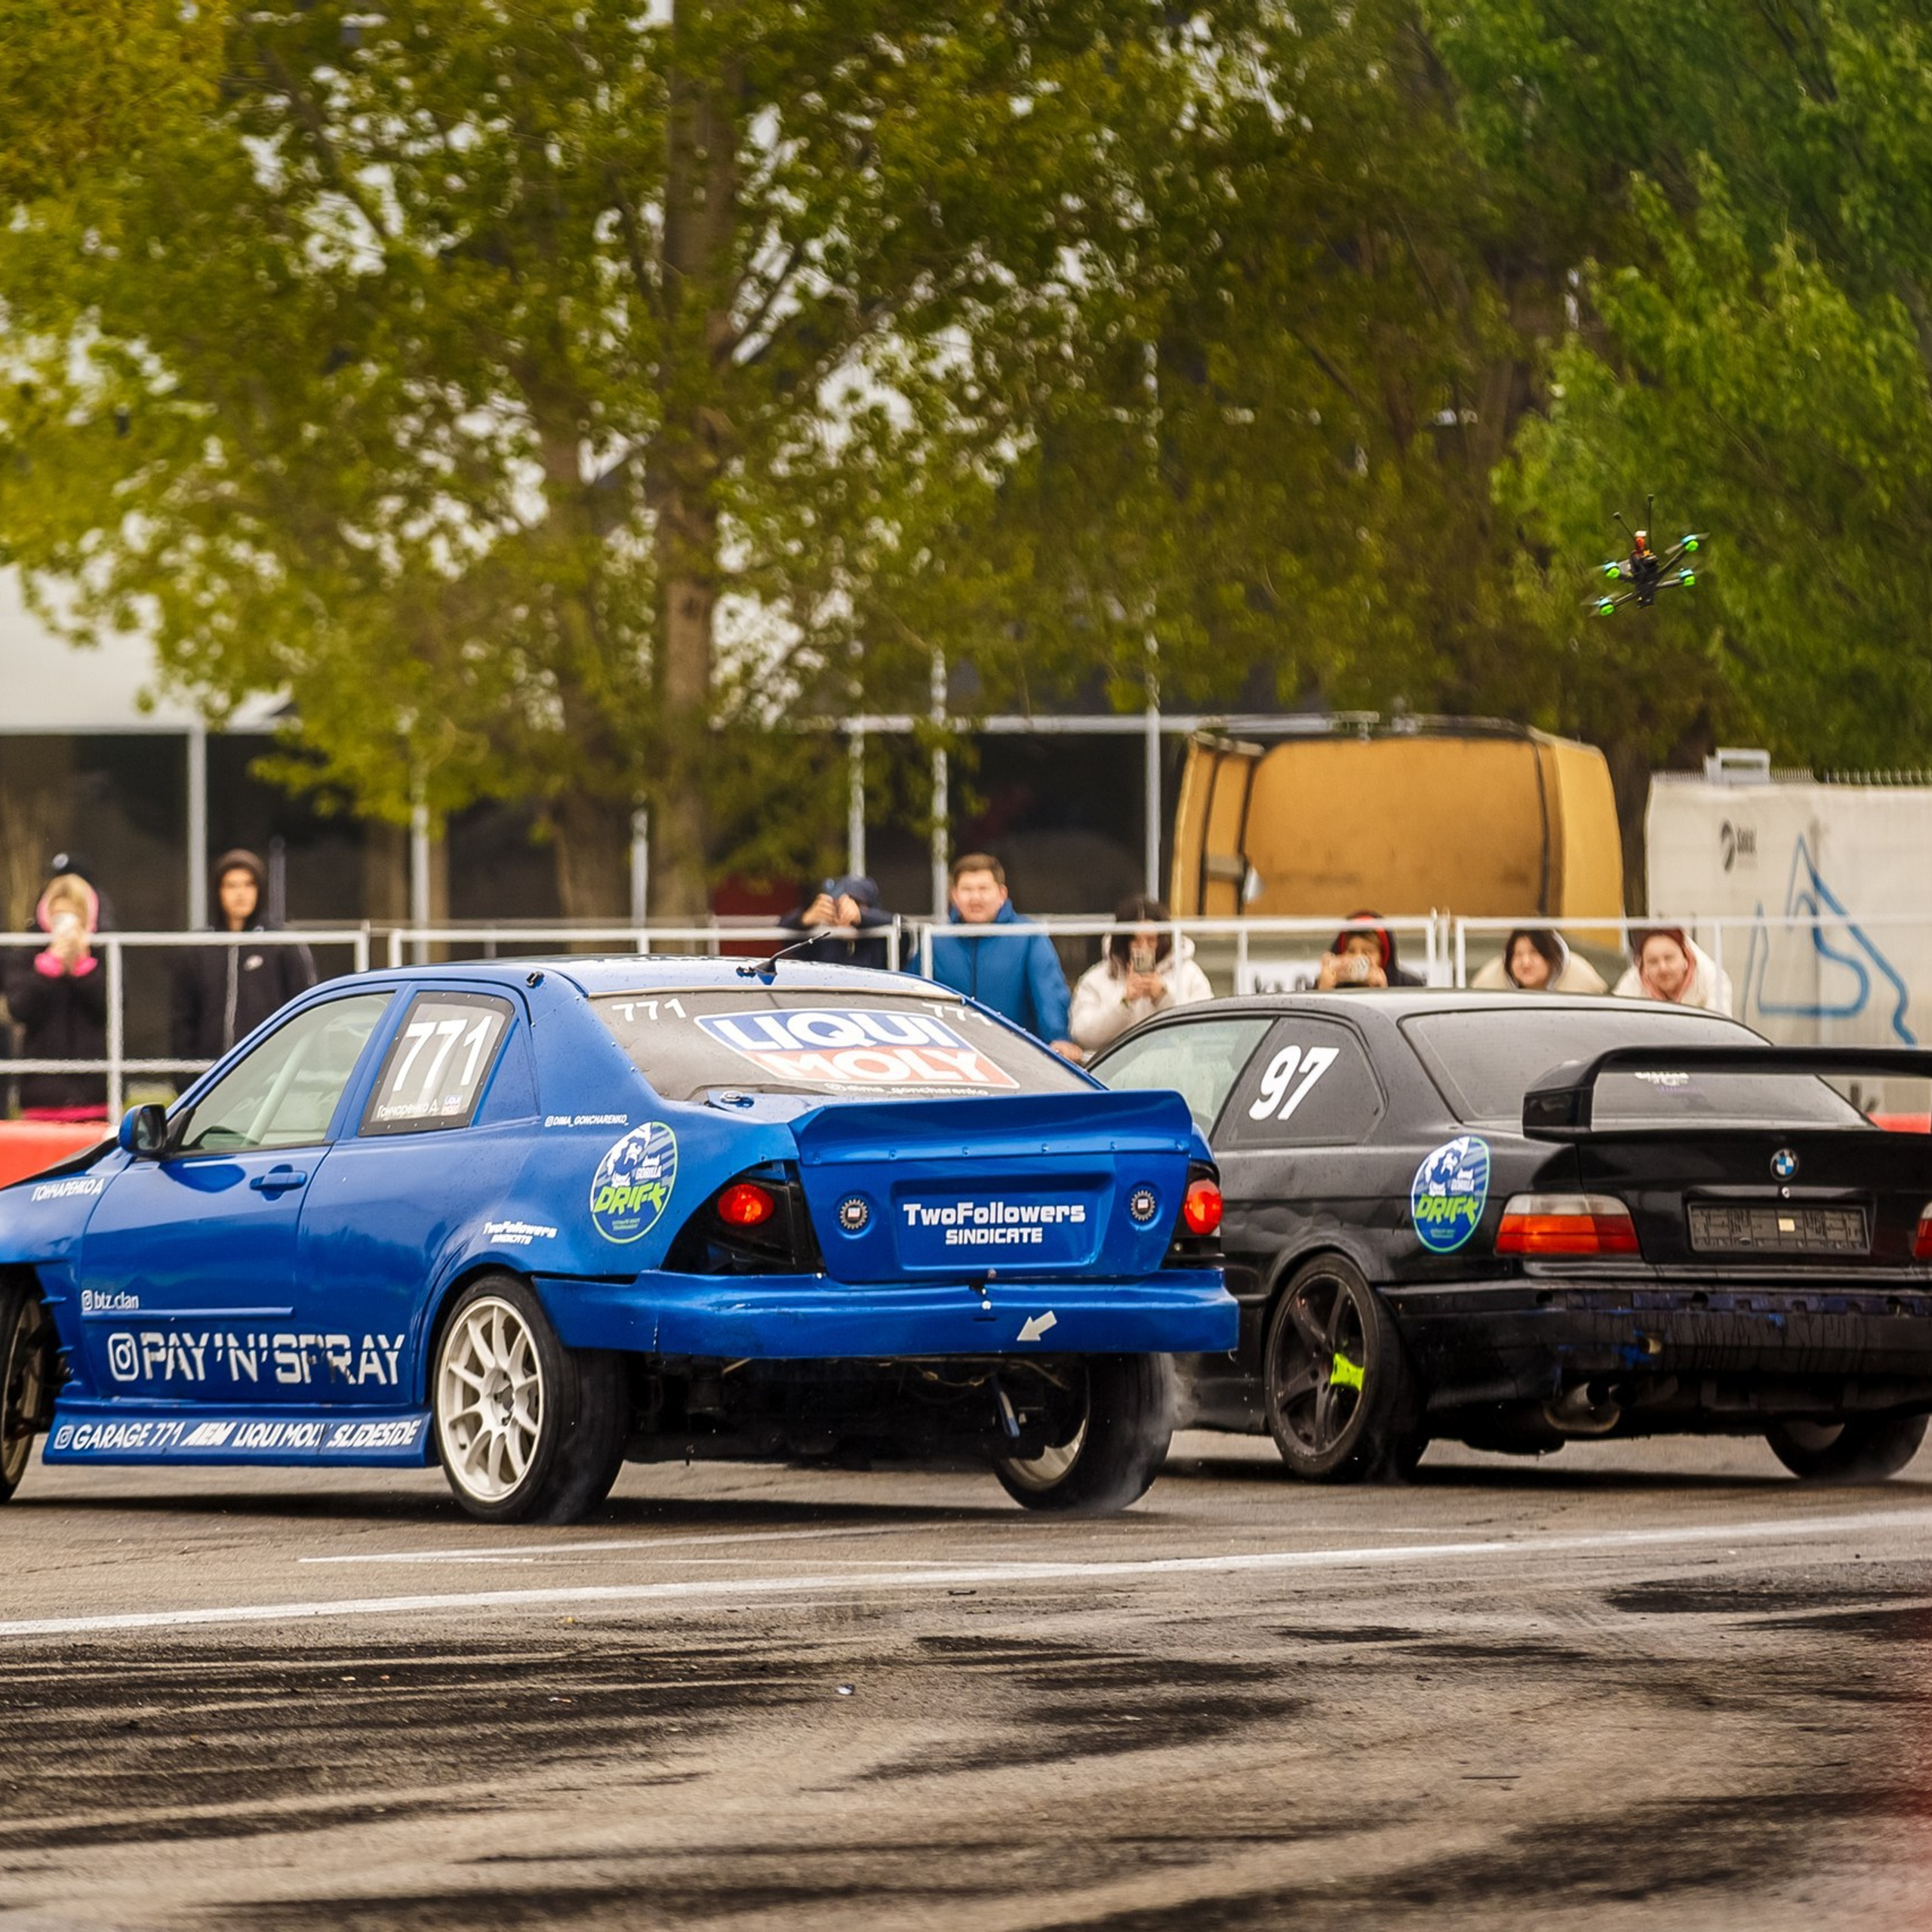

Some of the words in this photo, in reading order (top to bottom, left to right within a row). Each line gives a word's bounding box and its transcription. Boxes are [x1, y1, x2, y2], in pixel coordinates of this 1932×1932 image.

[611, 998, 687, 1022] 771
[921, 1002, 992, 1026] 771
[713, 1012, 959, 1050] LIQUI
[392, 1016, 493, 1092] 771
[756, 1049, 989, 1081] MOLY
[1248, 1044, 1340, 1120] 97
[903, 1201, 1086, 1226] TwoFollowers
[945, 1227, 1043, 1245] SINDICATE
[72, 1423, 153, 1450] GARAGE
[148, 1421, 186, 1447] 771
[232, 1422, 286, 1448] LIQUI
[326, 1420, 423, 1448] SLIDESIDE
